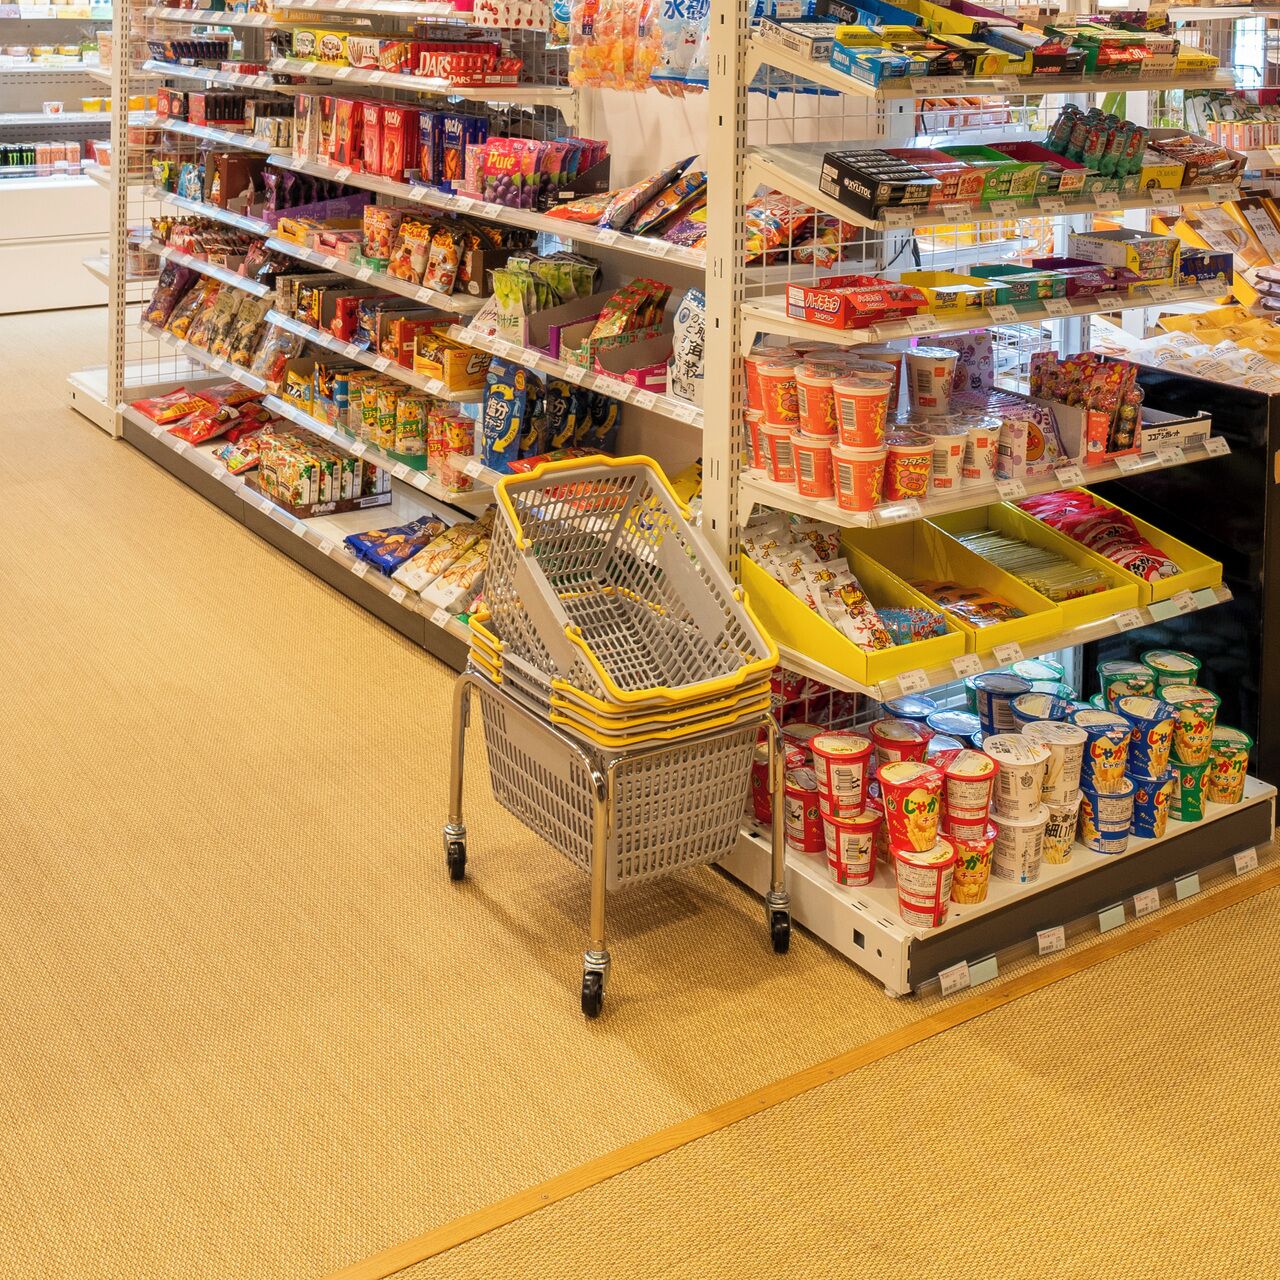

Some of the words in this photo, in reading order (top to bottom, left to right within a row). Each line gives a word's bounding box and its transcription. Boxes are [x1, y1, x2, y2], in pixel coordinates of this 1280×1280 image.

[414, 51, 451, 78] DARS
[448, 75, 471, 85] DARS
[848, 181, 871, 199] XYLITOL
[805, 293, 841, 314] ハイチュウ
